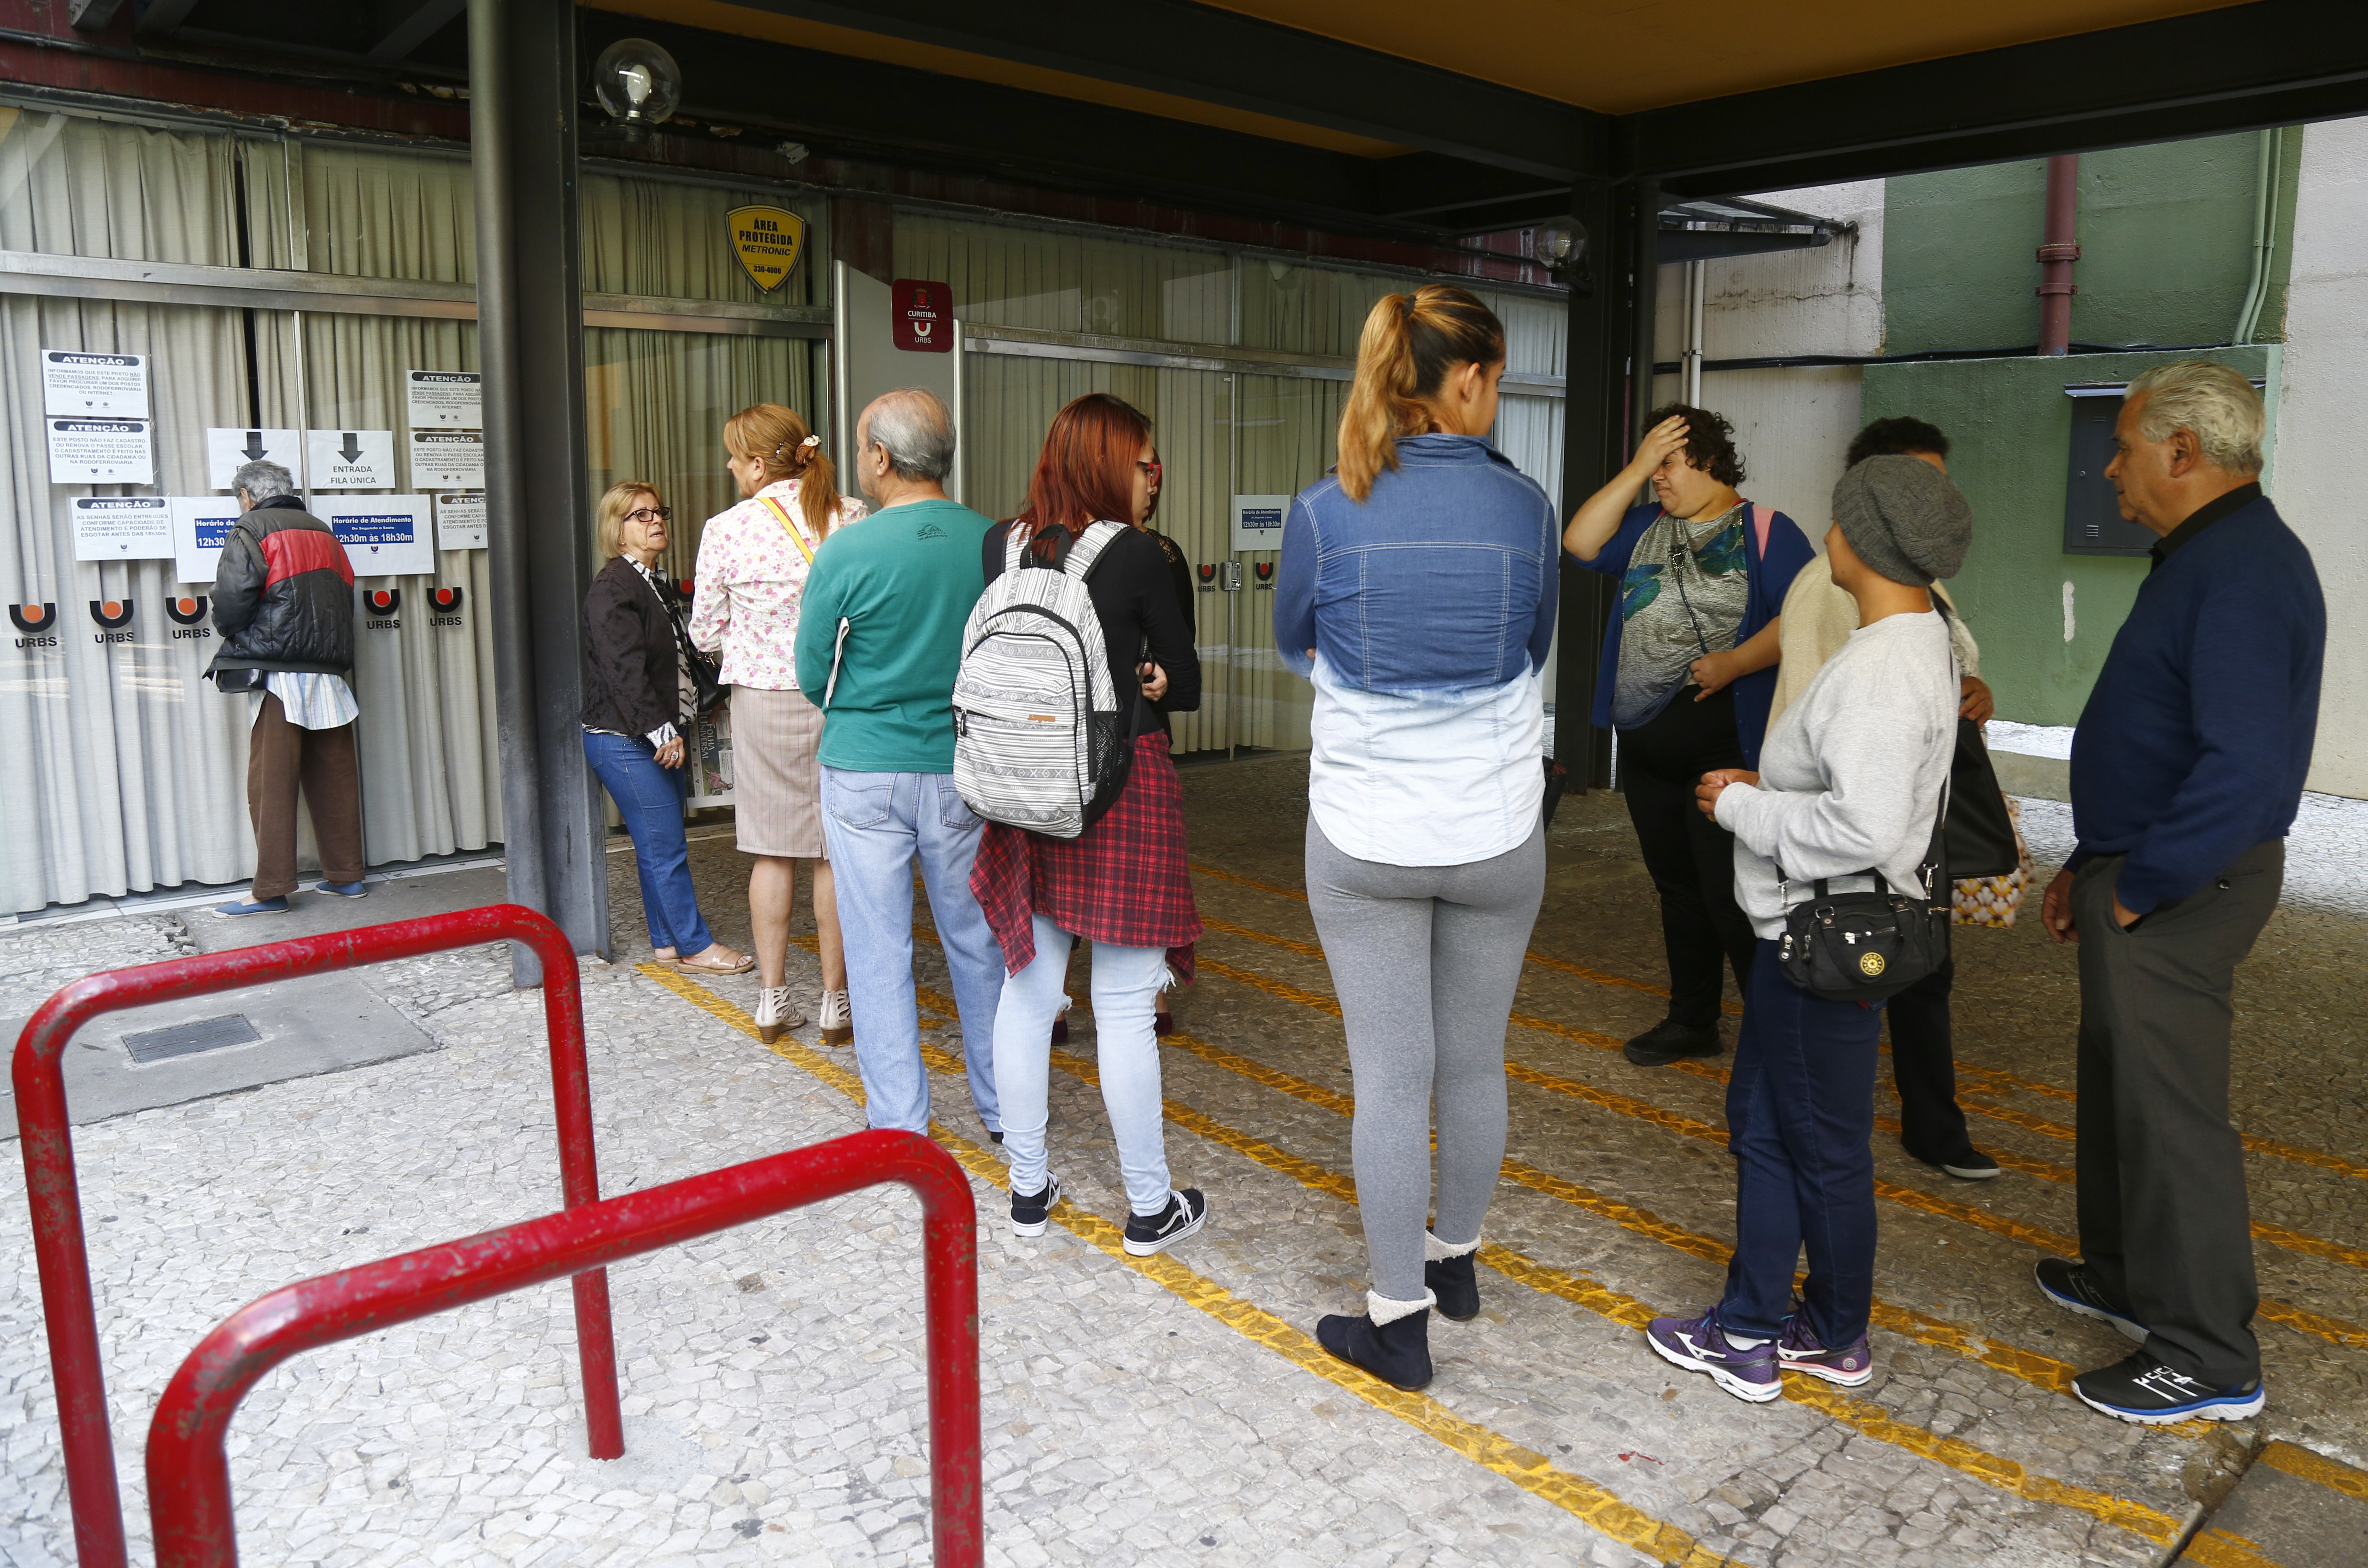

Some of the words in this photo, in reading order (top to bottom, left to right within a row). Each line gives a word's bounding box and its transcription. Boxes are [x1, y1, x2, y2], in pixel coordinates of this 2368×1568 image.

[754, 218, 778, 231] ÁREA
[739, 230, 793, 246] PROTEGIDA
[742, 245, 791, 256] METRONIC
[753, 265, 781, 274] 330-4000
[63, 356, 124, 365] ATENÇÃO
[198, 537, 225, 547] 12h30
[369, 534, 379, 542] às
[381, 533, 413, 541] 18h30m
[367, 620, 400, 629] URBS
[430, 617, 462, 626] URBS
[95, 632, 135, 644] URBS
[172, 628, 211, 639] URBS
[15, 636, 57, 648] URBS
[699, 716, 709, 761] UNIVERSAL
[706, 724, 715, 751] FOLHA
[1863, 954, 1882, 963] SPORT
